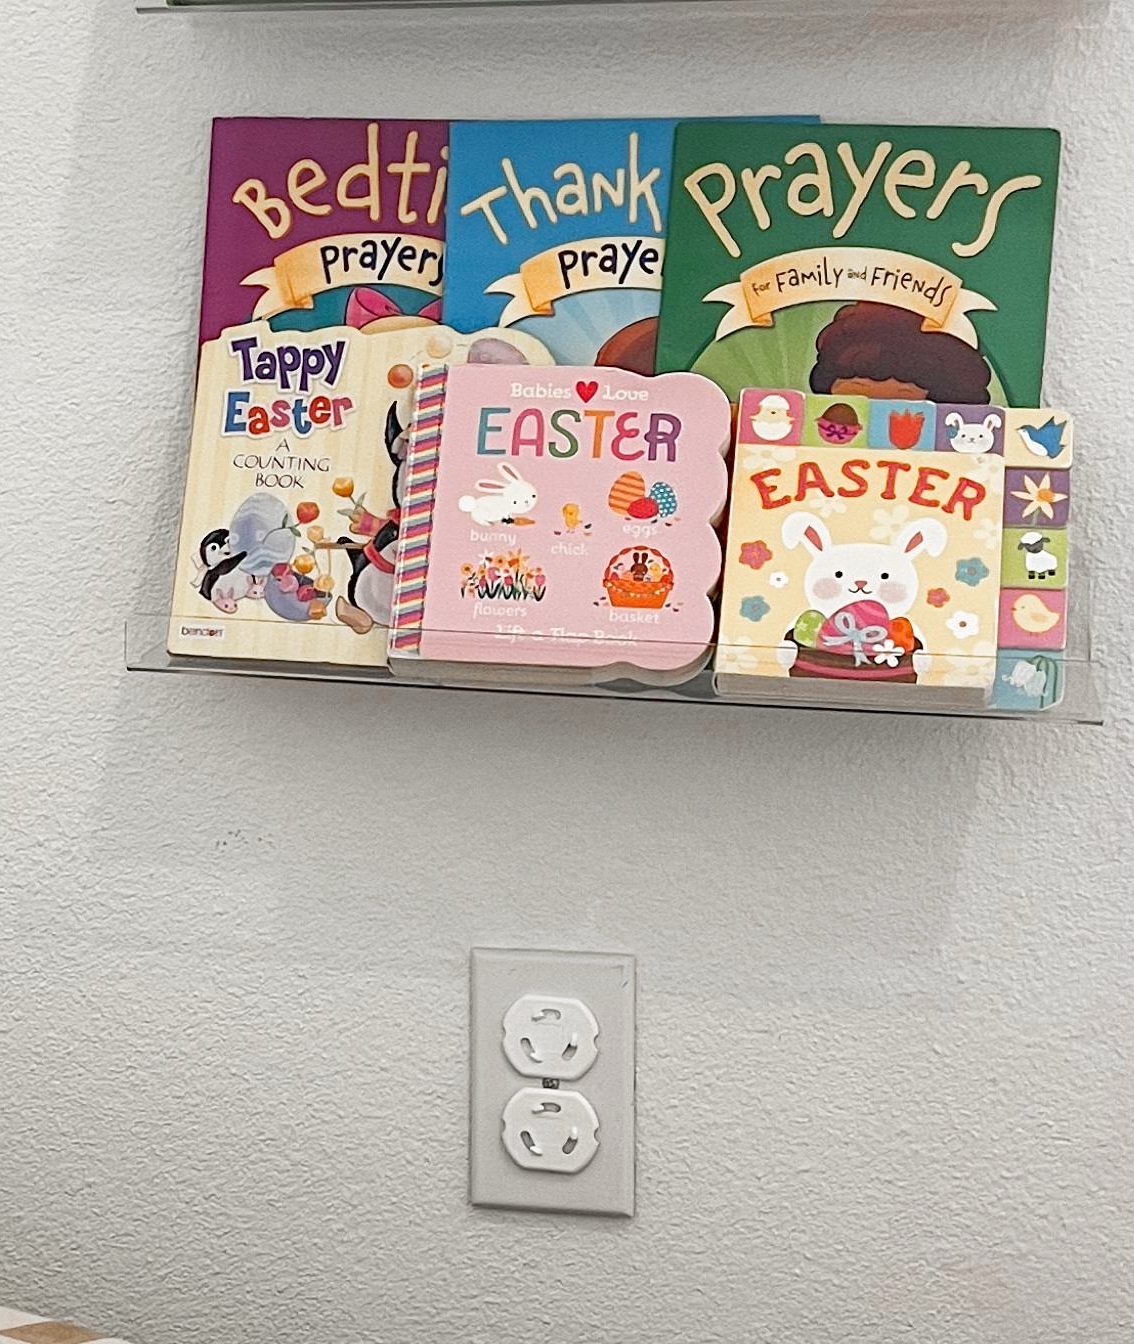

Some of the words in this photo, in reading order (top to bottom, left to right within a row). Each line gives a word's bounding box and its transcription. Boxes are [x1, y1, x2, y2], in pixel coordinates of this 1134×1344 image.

[232, 122, 448, 239] Bedti
[558, 239, 665, 289] praye
[230, 336, 347, 392] Tappy
[510, 382, 572, 400] Babies
[602, 384, 649, 402] Love
[223, 391, 354, 435] Easter
[477, 407, 682, 462] EASTER
[276, 438, 291, 452] A
[233, 453, 332, 473] COUNTING
[255, 473, 306, 490] BOOK
[750, 459, 987, 522] EASTER
[470, 528, 517, 545] bunny
[622, 524, 659, 539] eggs
[551, 540, 588, 556] chick
[473, 602, 528, 619] flowers
[608, 609, 660, 624] basket
